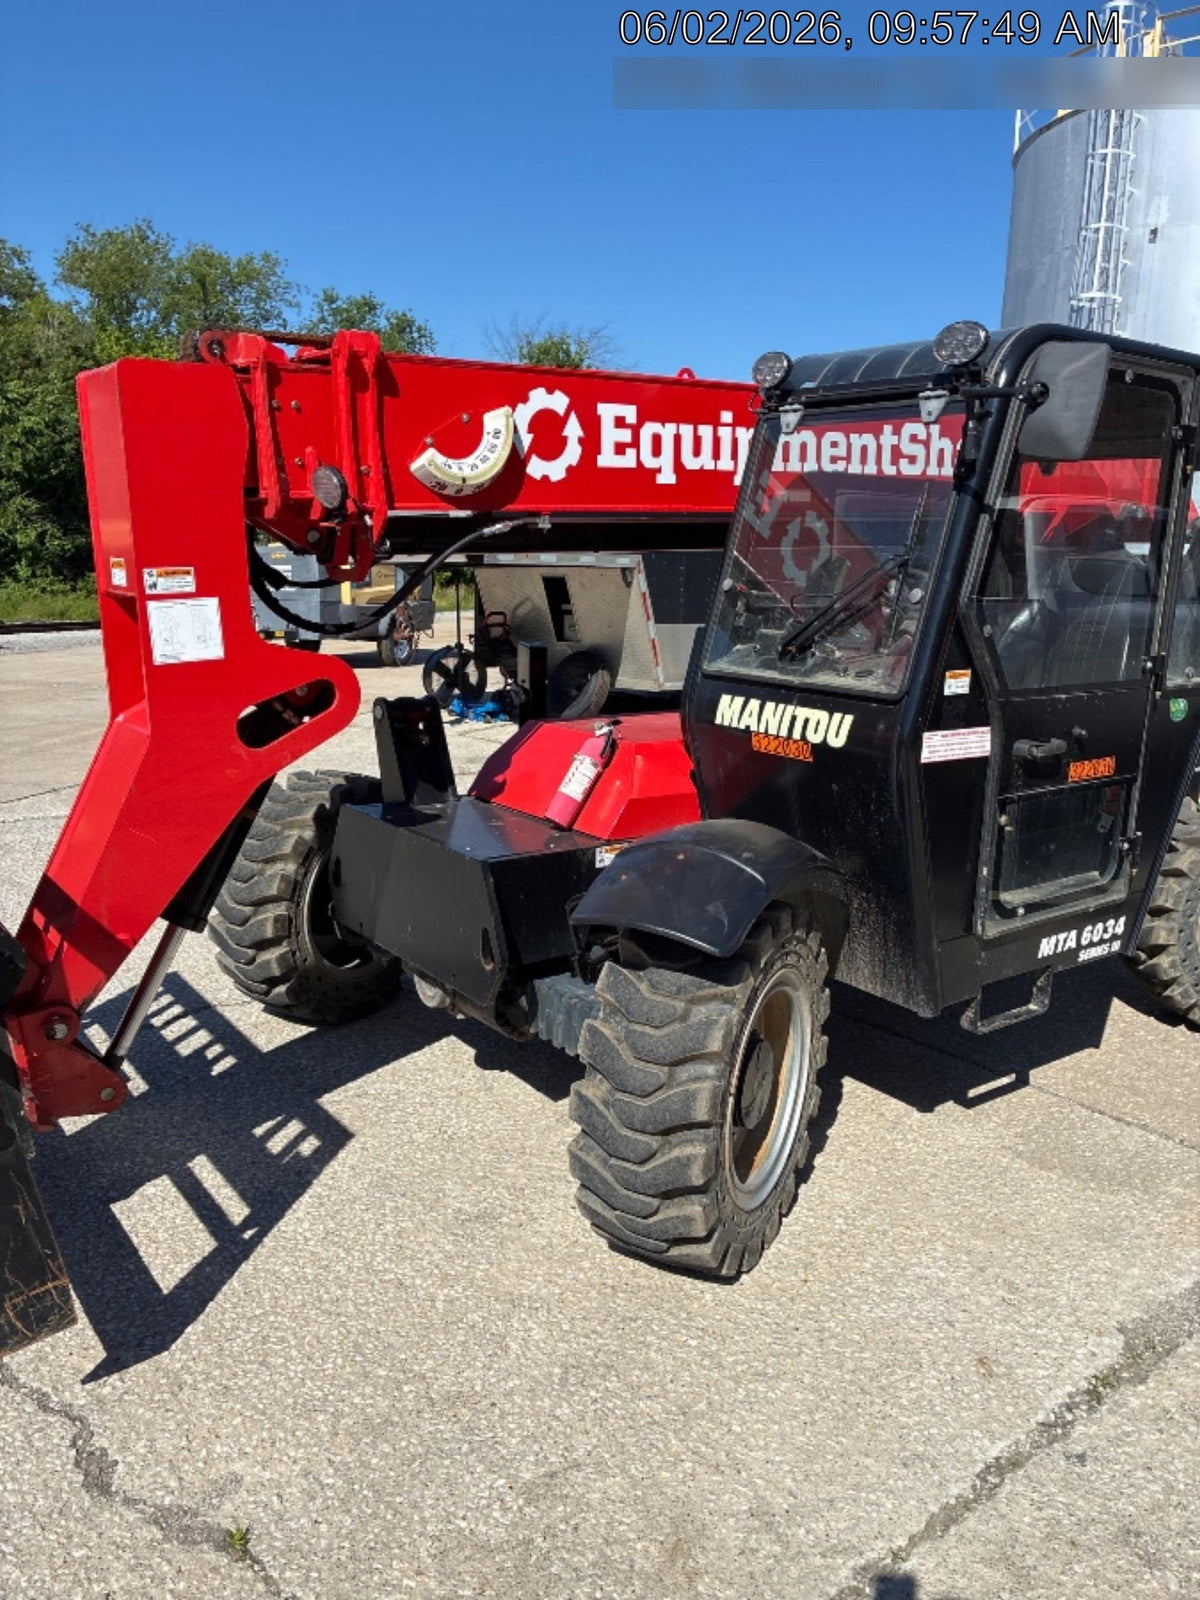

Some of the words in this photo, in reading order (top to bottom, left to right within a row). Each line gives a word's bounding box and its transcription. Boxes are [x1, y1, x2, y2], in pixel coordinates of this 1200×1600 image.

[714, 693, 855, 749] MANITOU
[1037, 929, 1078, 959] MTA
[1080, 915, 1126, 946] 6034
[1077, 942, 1110, 962] SERIES
